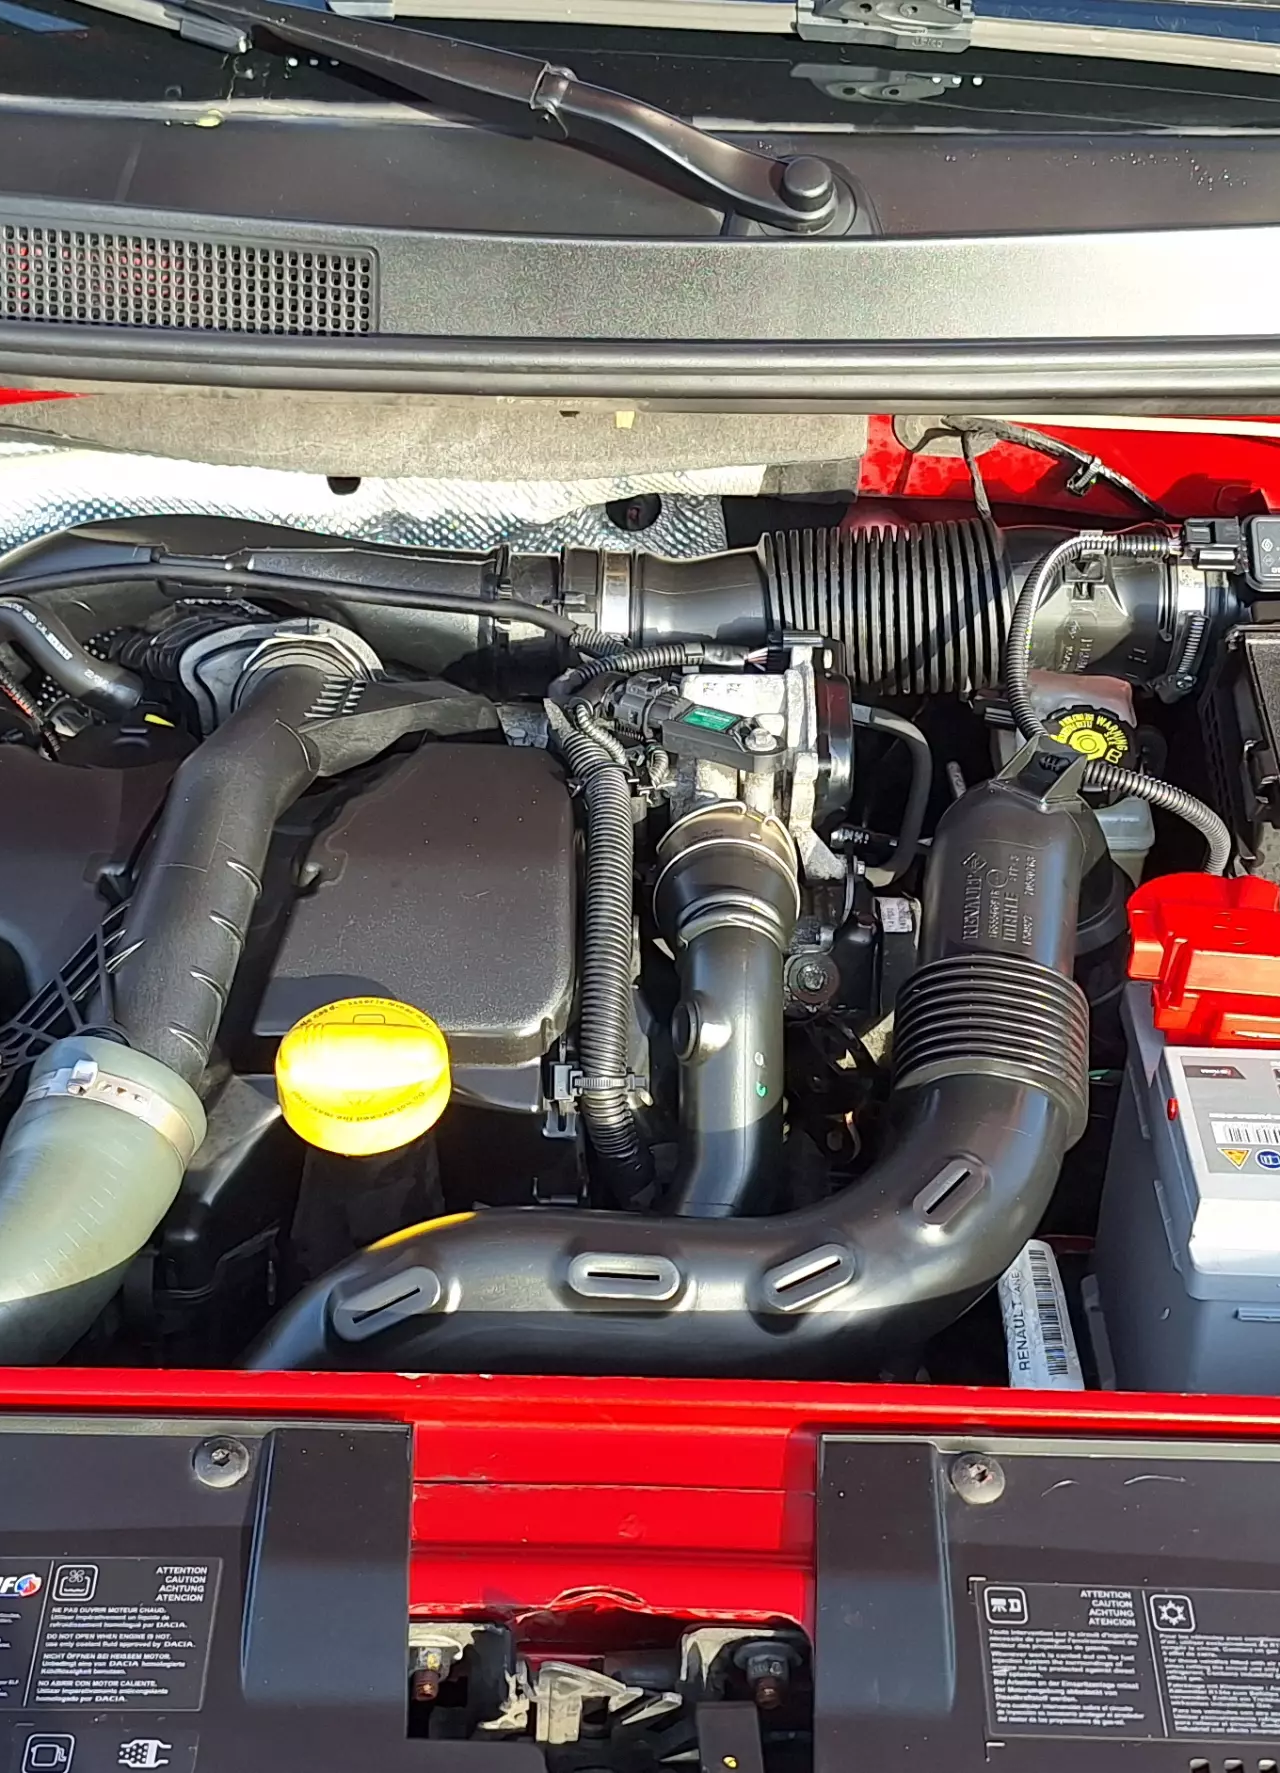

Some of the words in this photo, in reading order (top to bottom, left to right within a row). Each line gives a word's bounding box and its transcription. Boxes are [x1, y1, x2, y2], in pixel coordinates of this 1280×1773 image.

[1097, 716, 1128, 751] WARNING
[1011, 1300, 1031, 1371] RENAULT
[1080, 1590, 1131, 1598] ATTENTION
[1092, 1600, 1132, 1608] CAUTION
[1089, 1608, 1134, 1617] ACHTUNG
[1089, 1618, 1136, 1626] ATENCION
